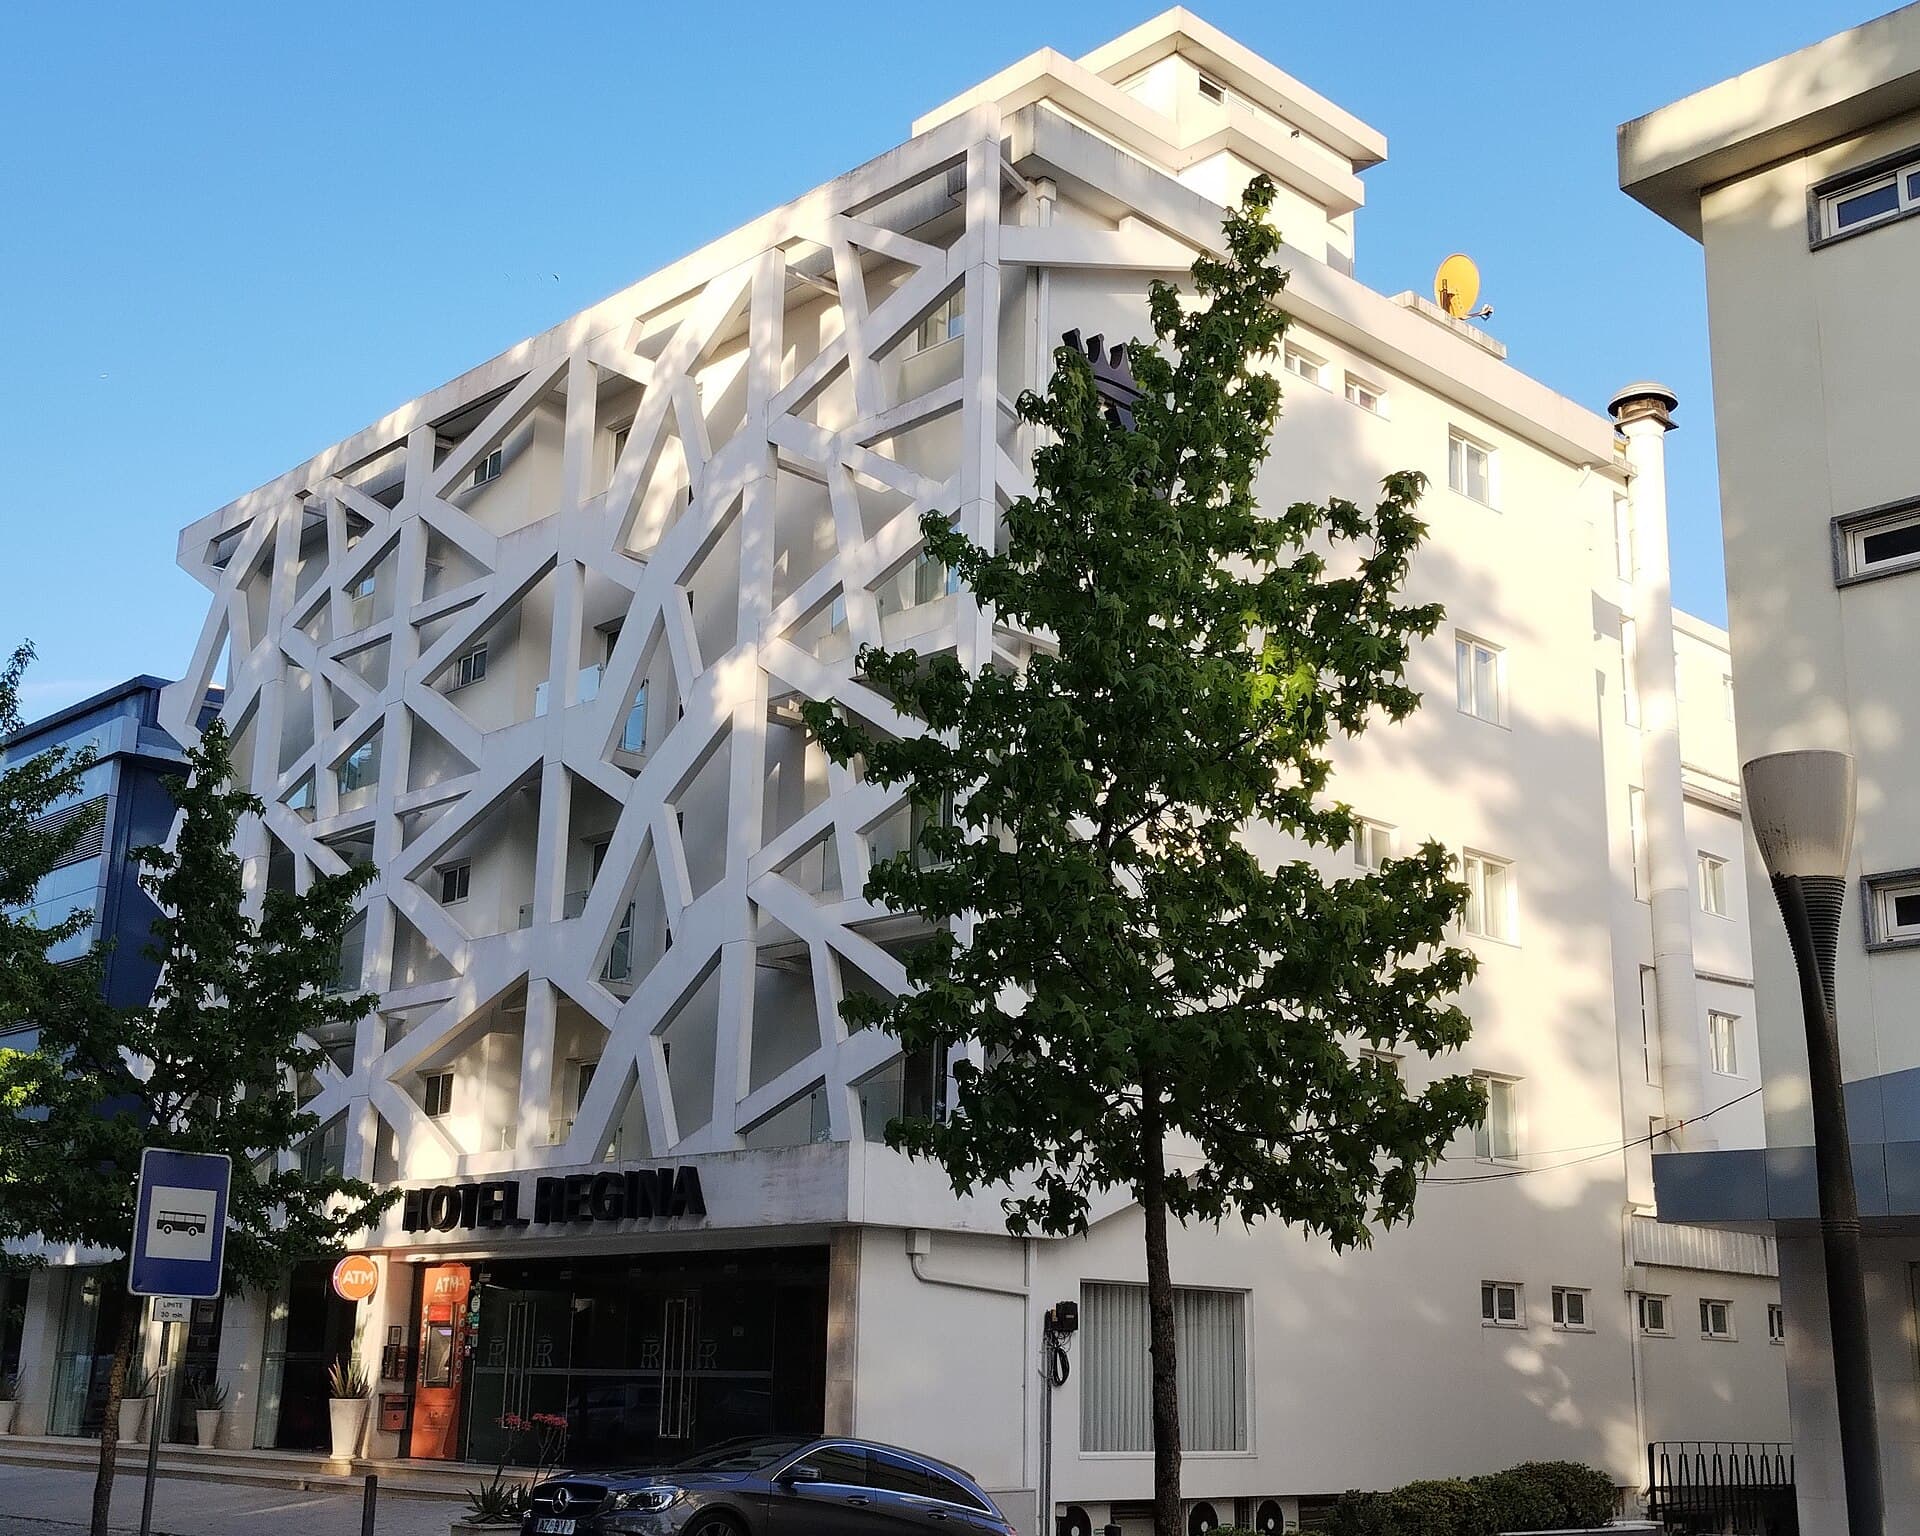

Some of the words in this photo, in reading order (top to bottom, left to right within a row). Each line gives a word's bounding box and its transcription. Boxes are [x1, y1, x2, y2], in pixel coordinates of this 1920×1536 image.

[401, 1180, 530, 1233] HOTEL
[534, 1165, 707, 1225] REGINA
[342, 1269, 374, 1286] ATM
[434, 1276, 459, 1293] ATM
